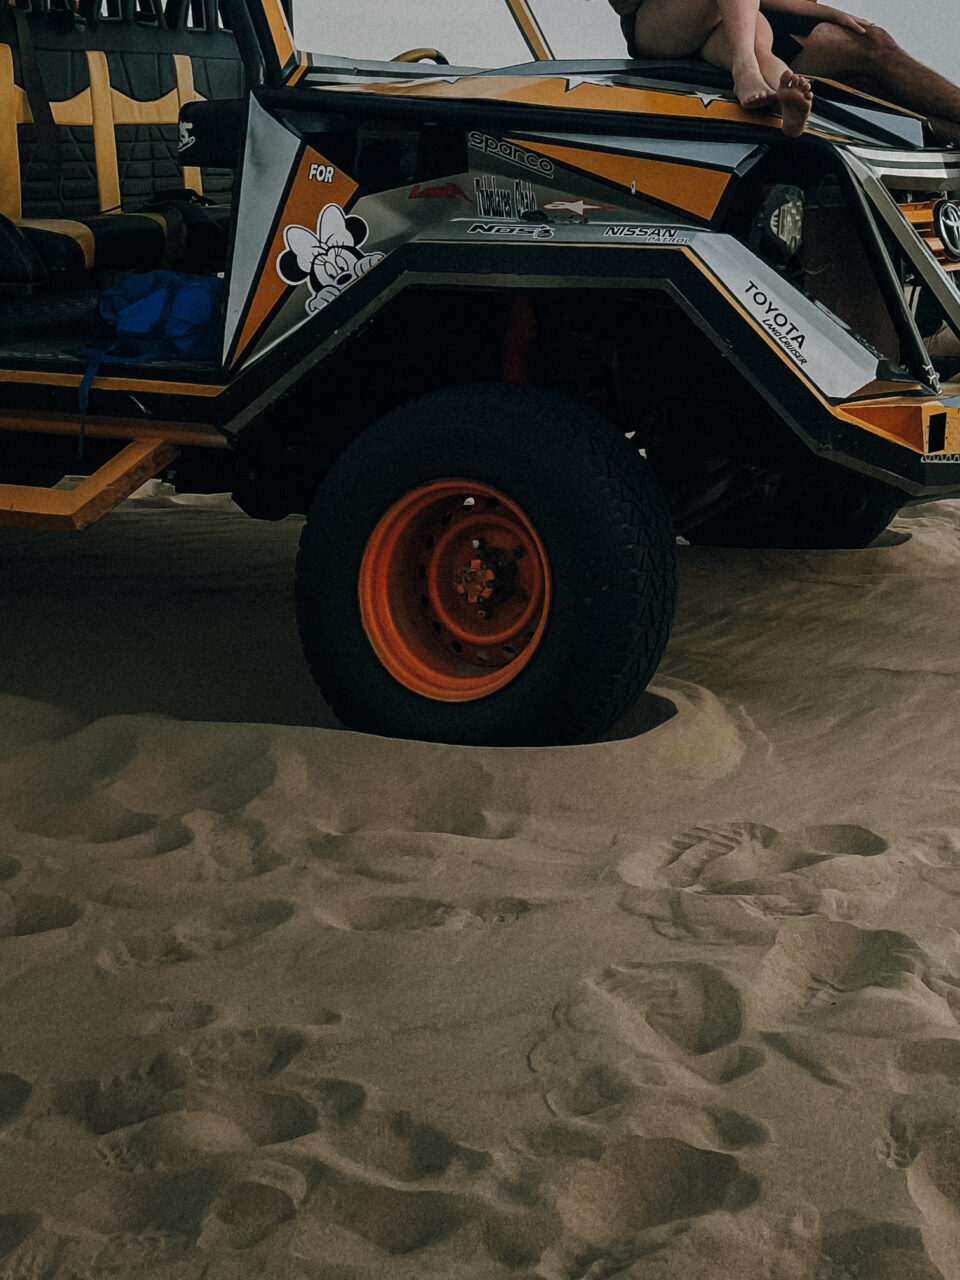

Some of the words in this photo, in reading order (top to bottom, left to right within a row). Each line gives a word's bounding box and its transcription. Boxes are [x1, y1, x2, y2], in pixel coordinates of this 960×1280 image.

[468, 131, 555, 174] sparco
[309, 163, 335, 183] FOR
[604, 226, 678, 238] NISSAN
[647, 236, 689, 244] PATROL
[744, 280, 806, 349] TOYOTA
